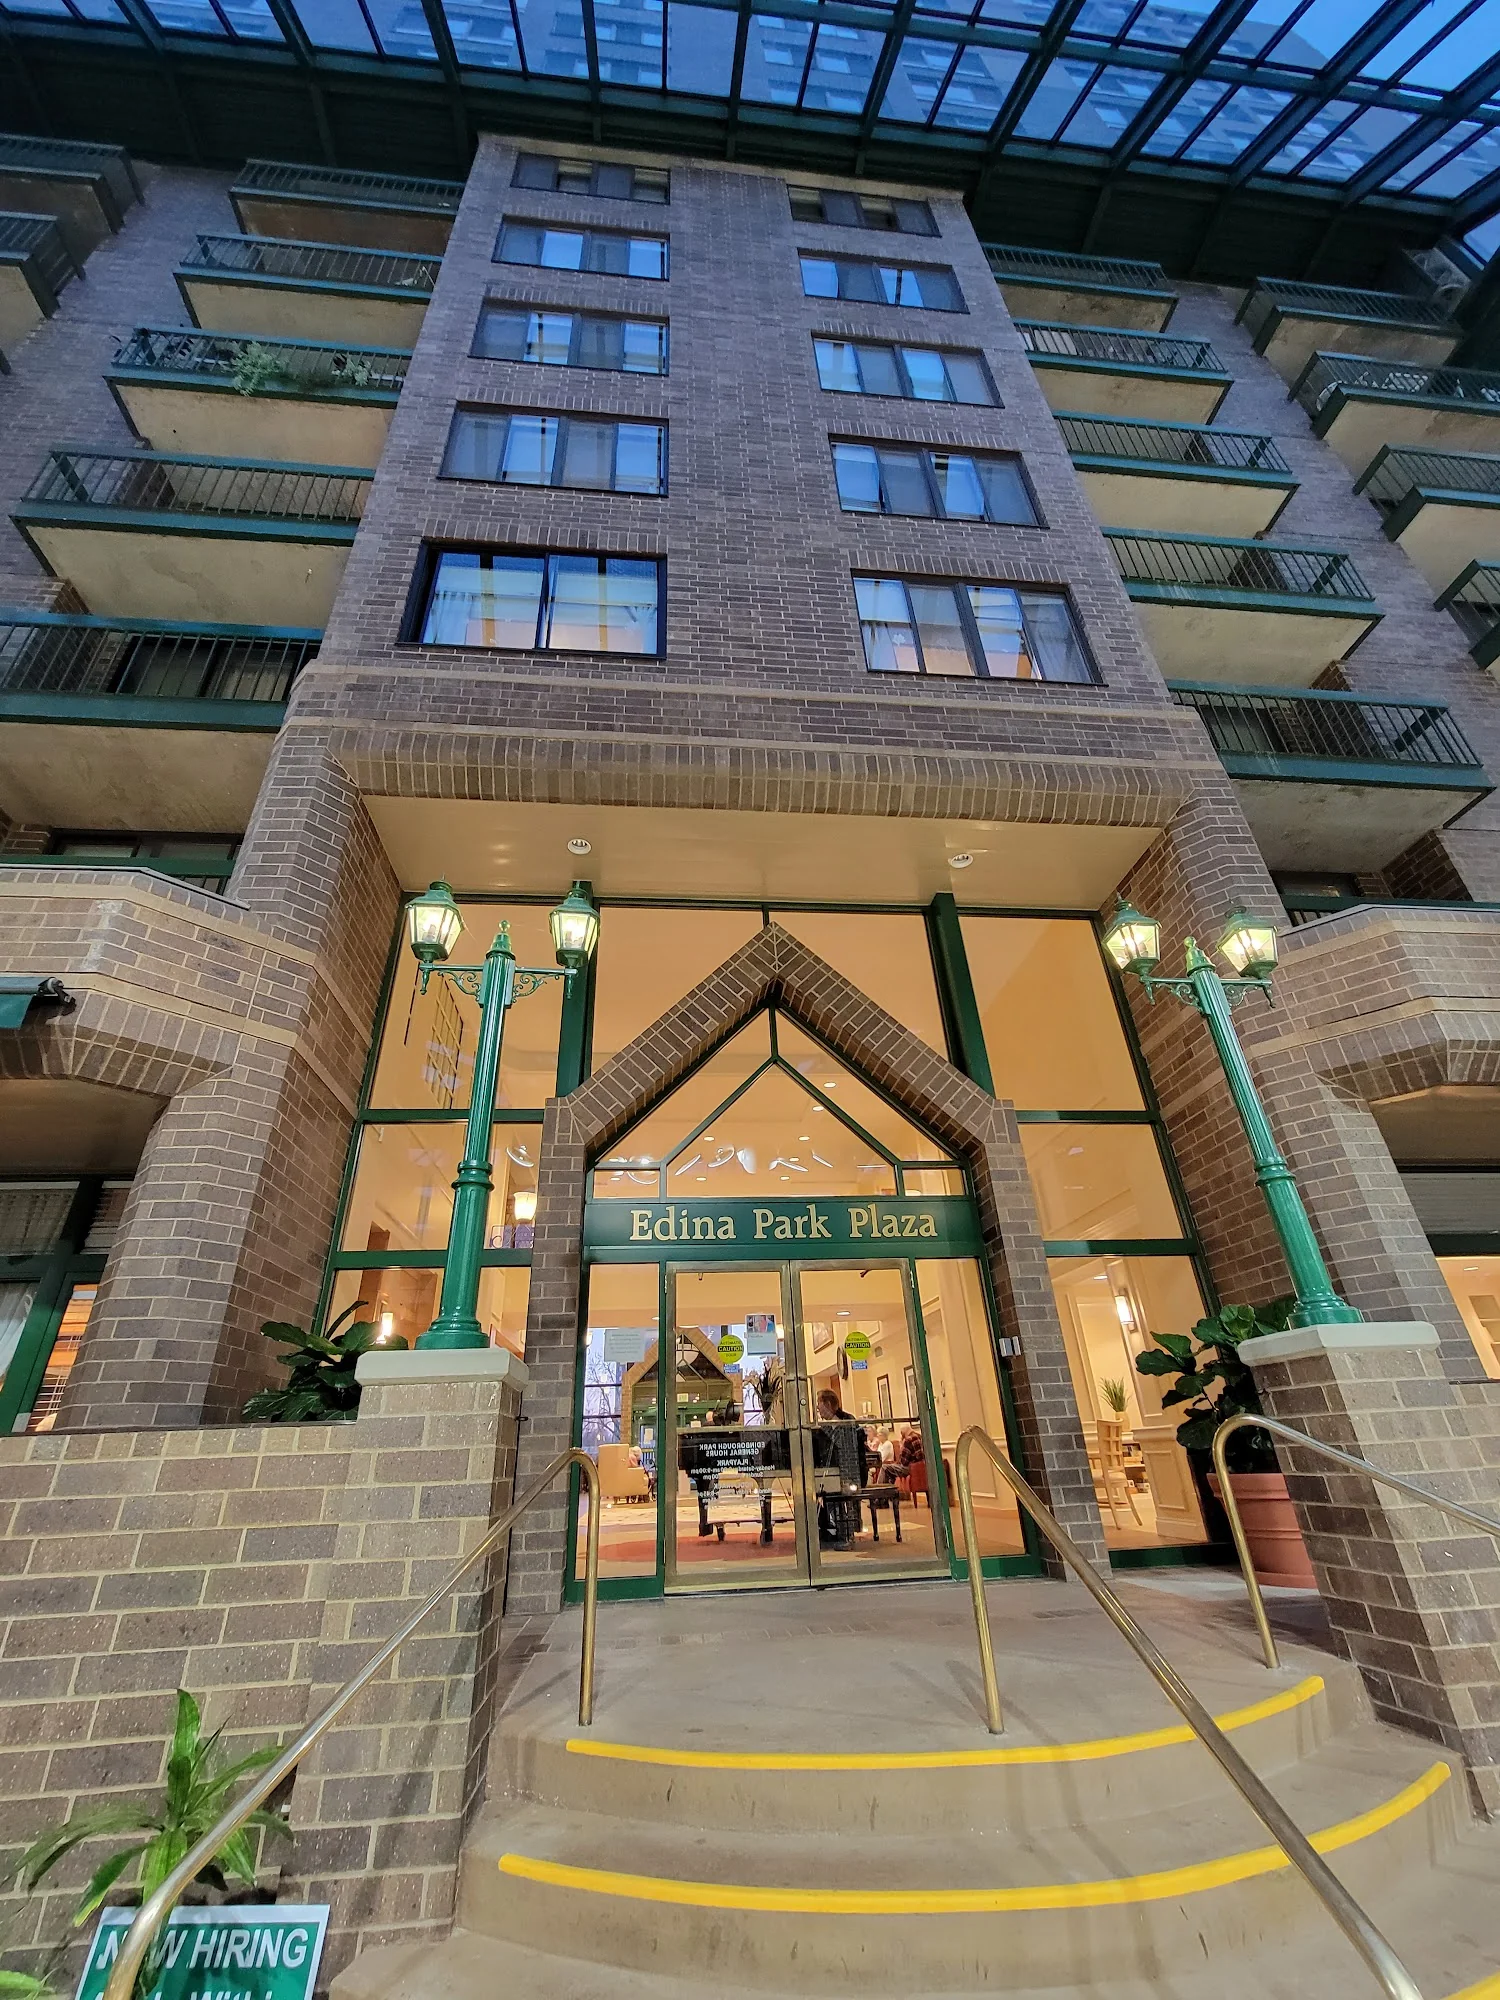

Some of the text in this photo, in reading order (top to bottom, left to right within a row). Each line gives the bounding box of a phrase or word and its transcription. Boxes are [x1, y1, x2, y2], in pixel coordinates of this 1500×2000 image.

[629, 1203, 938, 1241] Edina Park Plaza
[95, 1928, 310, 1970] NW HIRING
